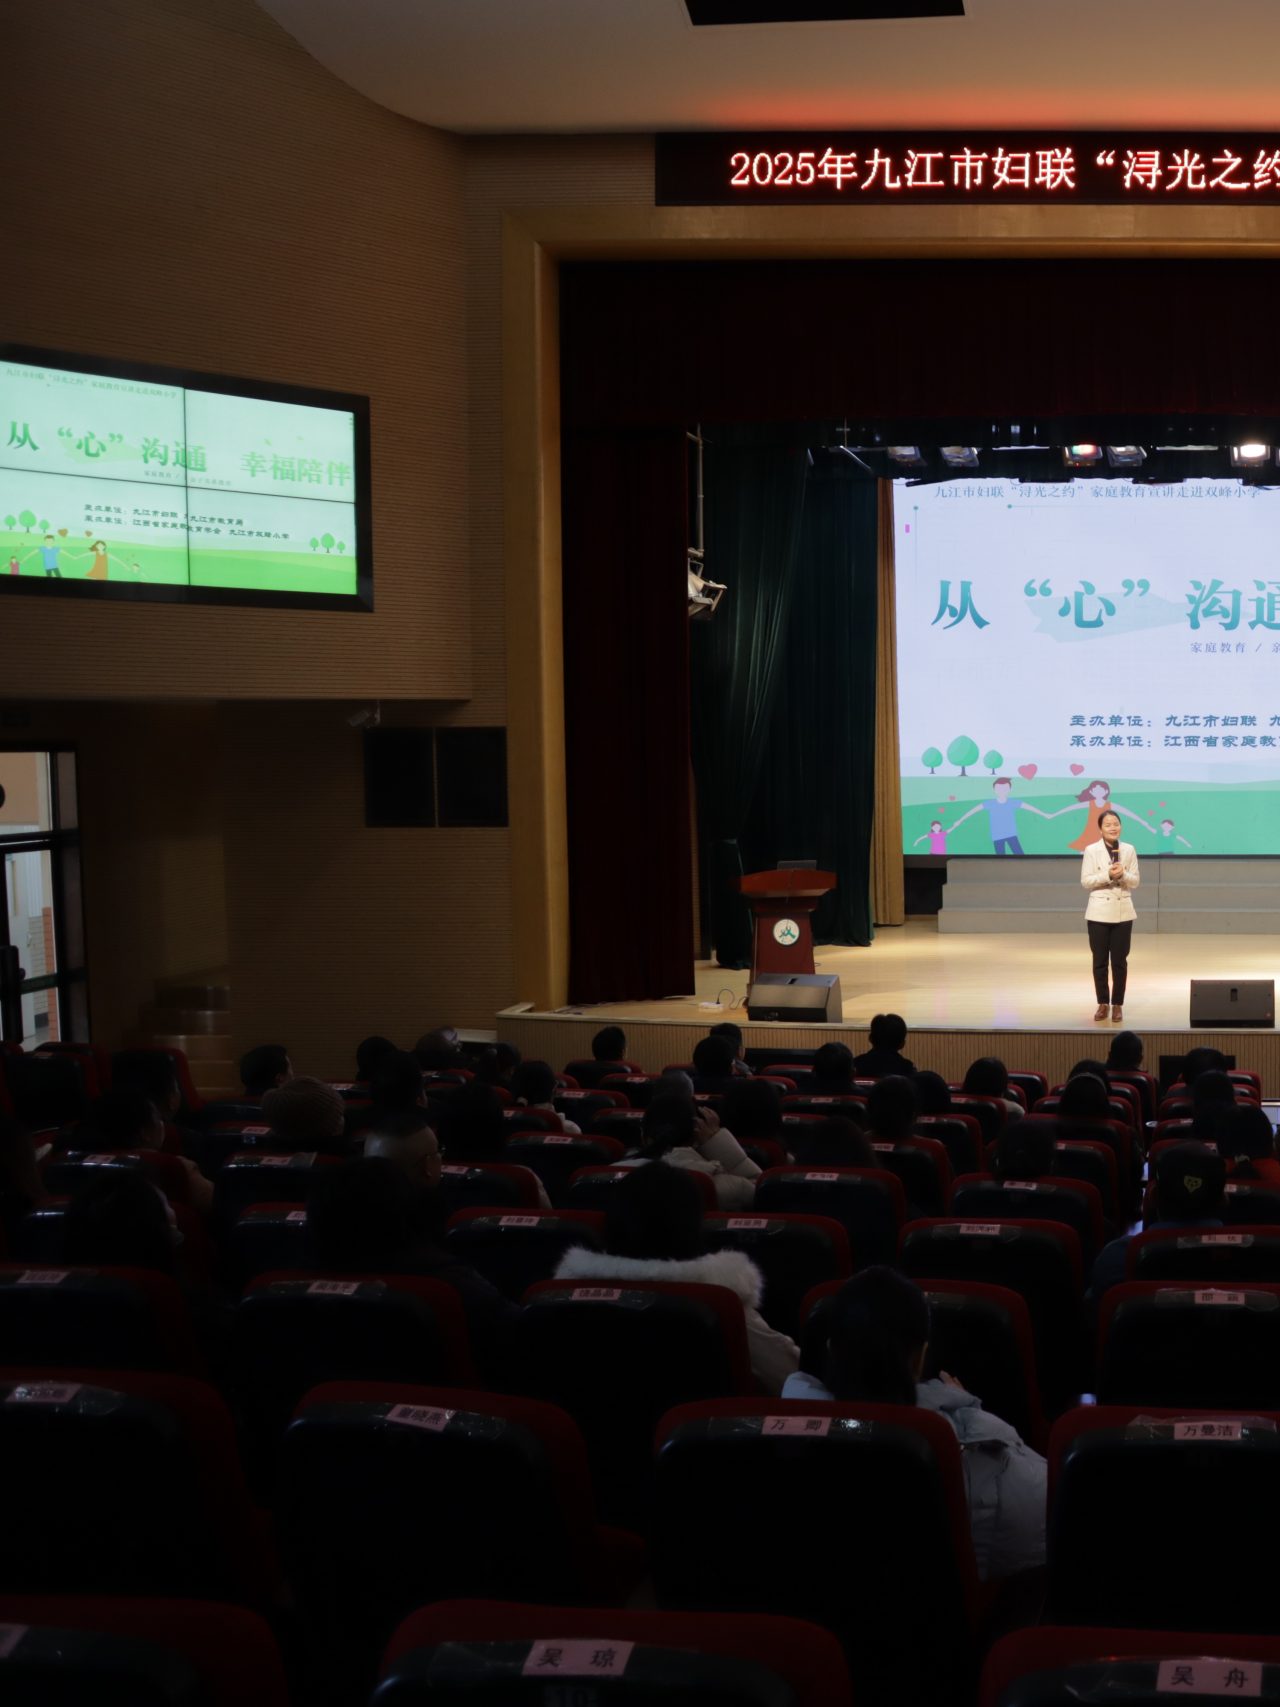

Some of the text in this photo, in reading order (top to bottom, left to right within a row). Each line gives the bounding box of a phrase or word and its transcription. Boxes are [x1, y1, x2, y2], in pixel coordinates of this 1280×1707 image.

[240, 450, 353, 488] 幸福陪伴
[1190, 641, 1246, 654] 家庭教育
